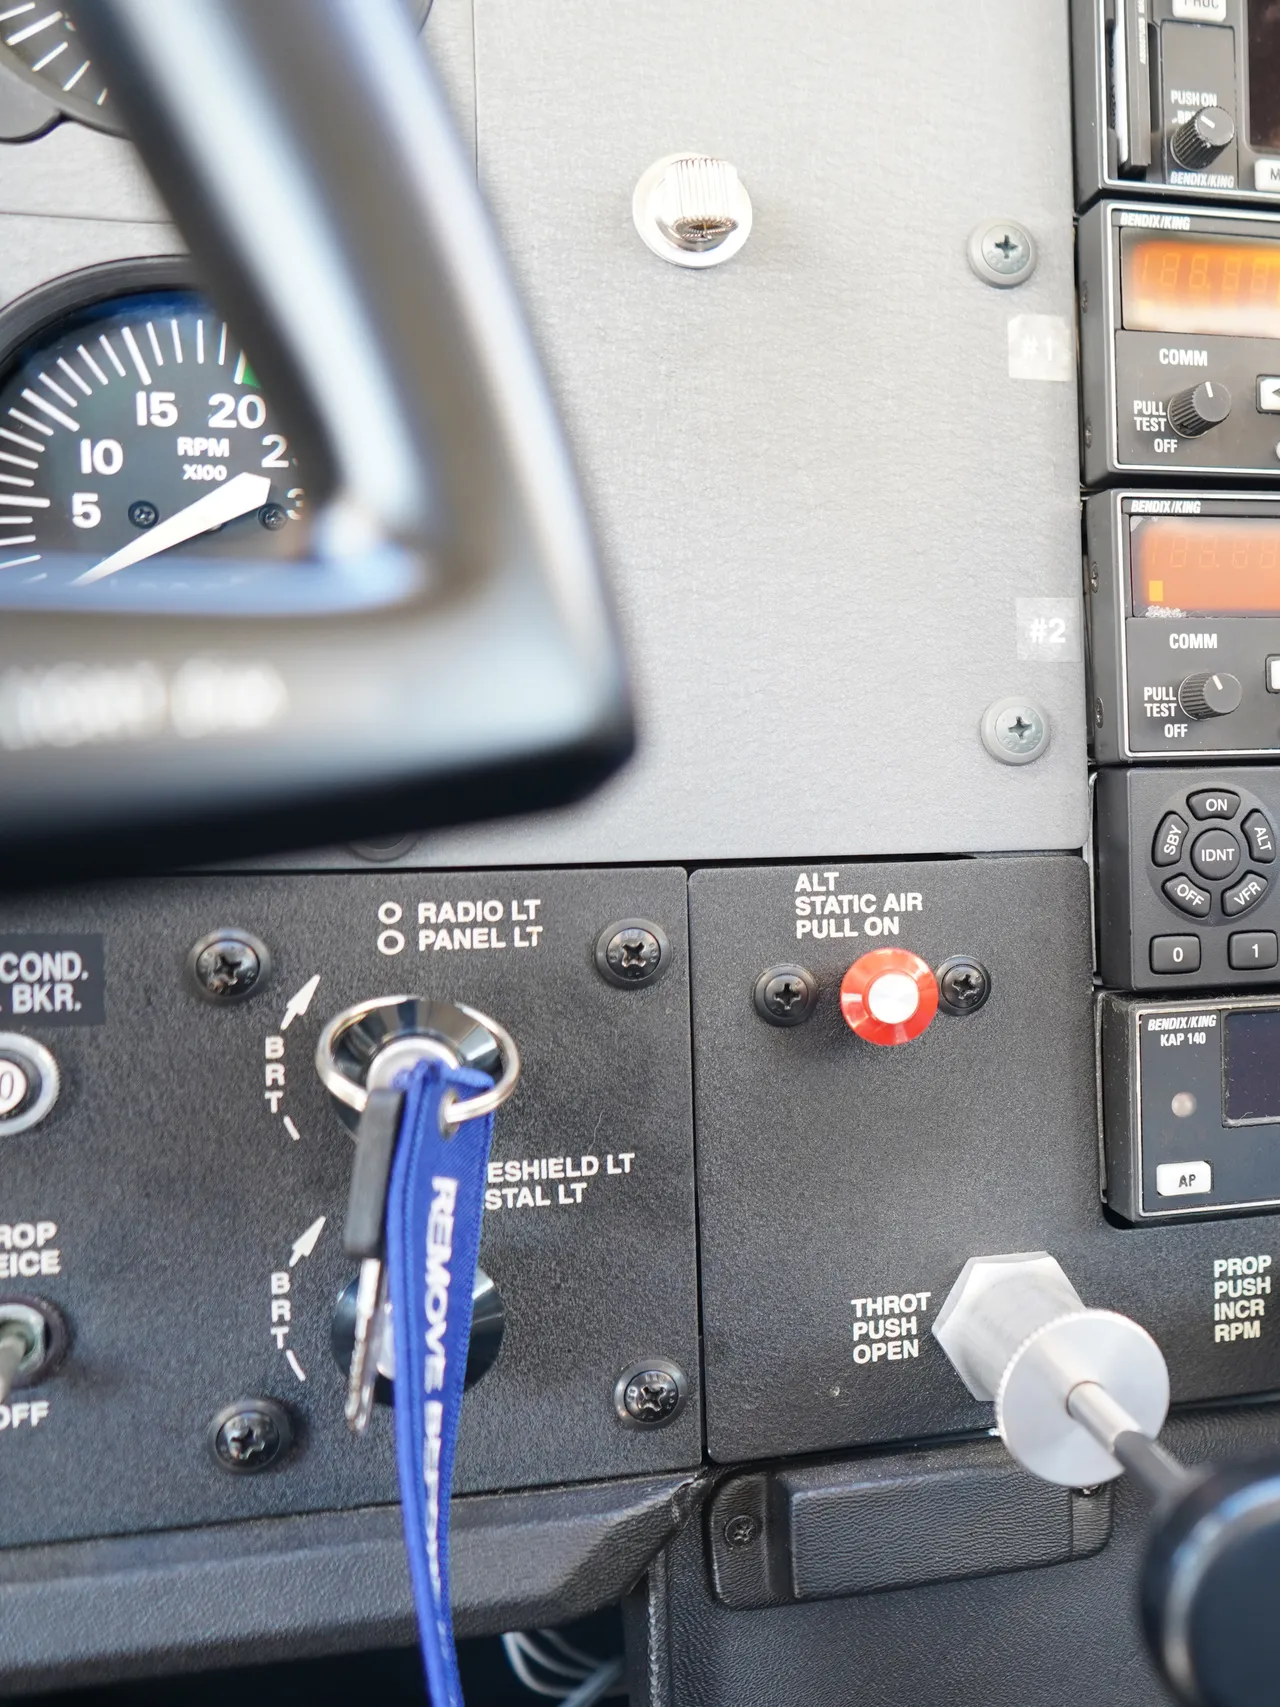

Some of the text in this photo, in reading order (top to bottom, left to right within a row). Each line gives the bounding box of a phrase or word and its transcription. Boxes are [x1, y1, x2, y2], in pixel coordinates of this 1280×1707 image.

[1171, 89, 1218, 107] PUSH ON
[1170, 171, 1235, 189] BENDIX/KING
[1120, 212, 1191, 231] BENDIX/KING
[1159, 348, 1208, 368] COMM
[135, 391, 179, 428] 15
[208, 393, 267, 429] 20
[1133, 400, 1167, 417] PULL
[1134, 416, 1167, 432] TEST
[80, 438, 124, 475] 10
[177, 436, 230, 457] RPM
[1153, 438, 1178, 454] OFF
[71, 492, 102, 528] 5
[1130, 499, 1202, 514] BENDIX/KING
[1029, 617, 1067, 644] #2
[1169, 633, 1218, 649] COMM
[1143, 686, 1177, 702] PULL
[1143, 703, 1177, 718] TEST
[1163, 723, 1188, 738] OFF
[1205, 798, 1228, 812] ON
[1163, 824, 1182, 856] SBY
[1253, 825, 1273, 852] ALT
[1200, 848, 1236, 863] IDNT
[795, 872, 840, 892] ALT
[795, 892, 923, 916] STATIC AIR
[1175, 883, 1205, 907] OFF
[1233, 881, 1262, 907] VFR
[417, 898, 541, 925] RADIO LT
[417, 926, 543, 951] PANEL LT
[796, 916, 900, 939] PULL ON
[1172, 947, 1184, 963] 0
[1251, 943, 1260, 958] 1
[12, 982, 82, 1014] BKR.
[1147, 1014, 1217, 1031] BENDIX/KING
[1160, 1031, 1207, 1047] KAP 140
[264, 1035, 286, 1114] BRT
[486, 1152, 635, 1183] ESHIELD LT
[1178, 1174, 1197, 1188] AP
[558, 1183, 588, 1204] LT
[1213, 1254, 1273, 1279] PROP
[424, 1175, 459, 1395] REMOVE
[1214, 1276, 1272, 1299] PUSH
[270, 1271, 291, 1349] BRT
[850, 1291, 932, 1319] THROT
[1213, 1298, 1266, 1321] INCR
[852, 1316, 917, 1342] PUSH
[1214, 1320, 1261, 1343] RPM
[852, 1339, 919, 1365] OPEN
